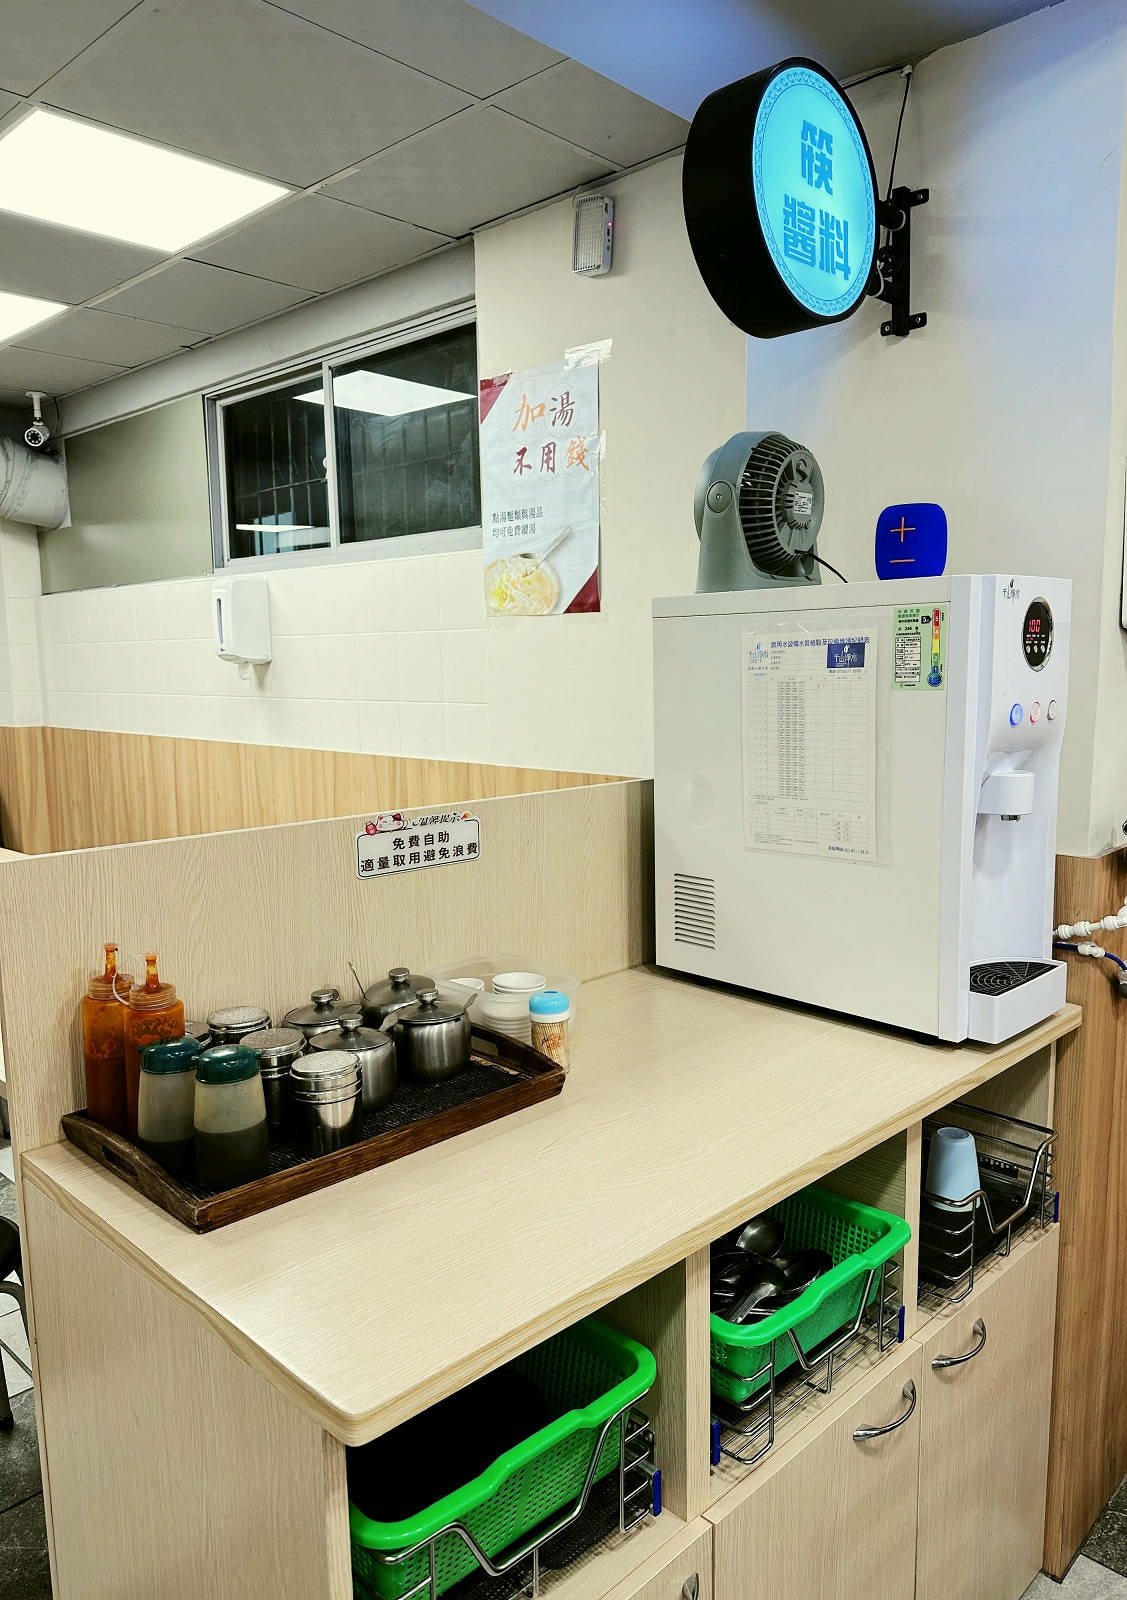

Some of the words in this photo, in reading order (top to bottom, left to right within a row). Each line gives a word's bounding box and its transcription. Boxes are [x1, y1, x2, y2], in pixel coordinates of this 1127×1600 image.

[800, 119, 834, 196] 筷
[783, 193, 852, 281] 醬料
[513, 389, 576, 433] 加湯
[512, 435, 590, 477] 不用錢
[1028, 619, 1041, 633] 100
[360, 842, 479, 873] 適量取用避免浪費
[391, 830, 451, 851] 免費自助
